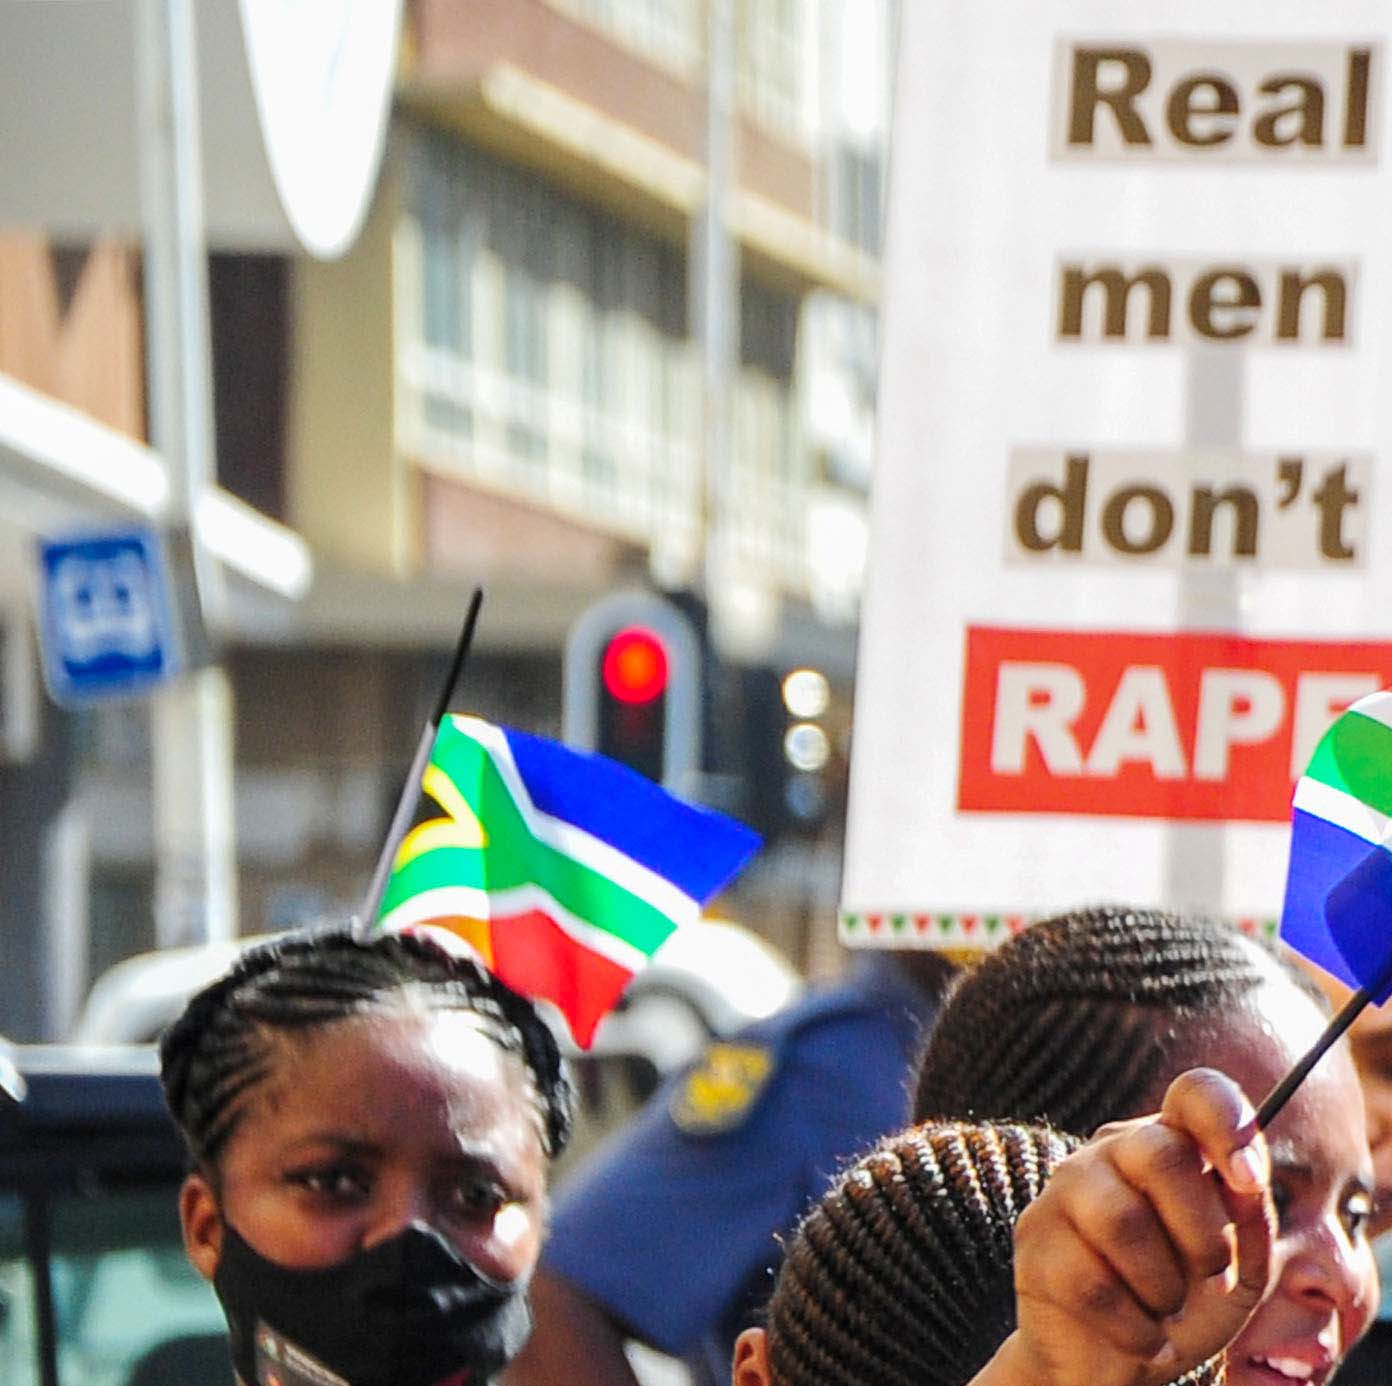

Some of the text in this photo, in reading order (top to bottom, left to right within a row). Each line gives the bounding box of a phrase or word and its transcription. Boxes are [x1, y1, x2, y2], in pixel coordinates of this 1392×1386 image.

[1067, 46, 1373, 150] Real
[1057, 259, 1350, 345] men
[1013, 452, 1360, 561] don't
